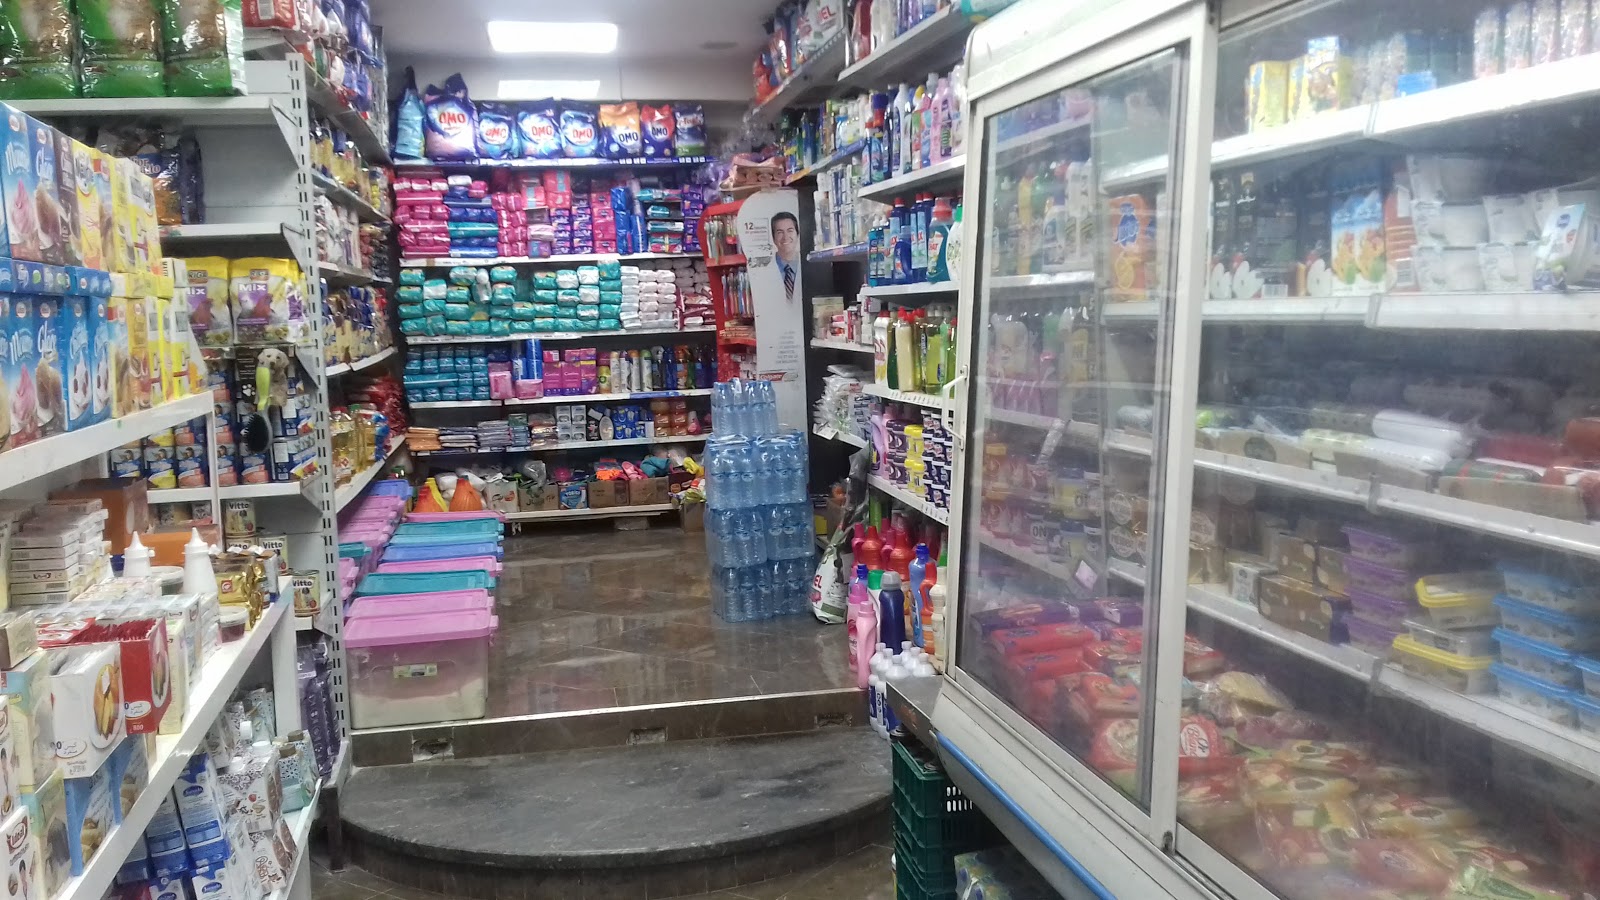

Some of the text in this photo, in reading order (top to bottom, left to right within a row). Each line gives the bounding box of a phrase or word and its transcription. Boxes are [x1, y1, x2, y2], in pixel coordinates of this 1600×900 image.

[439, 112, 466, 124] OMO
[532, 126, 553, 137] OMO
[573, 128, 593, 138] OMO
[651, 127, 668, 136] OMO
[619, 132, 638, 142] OMO
[744, 222, 754, 230] 12
